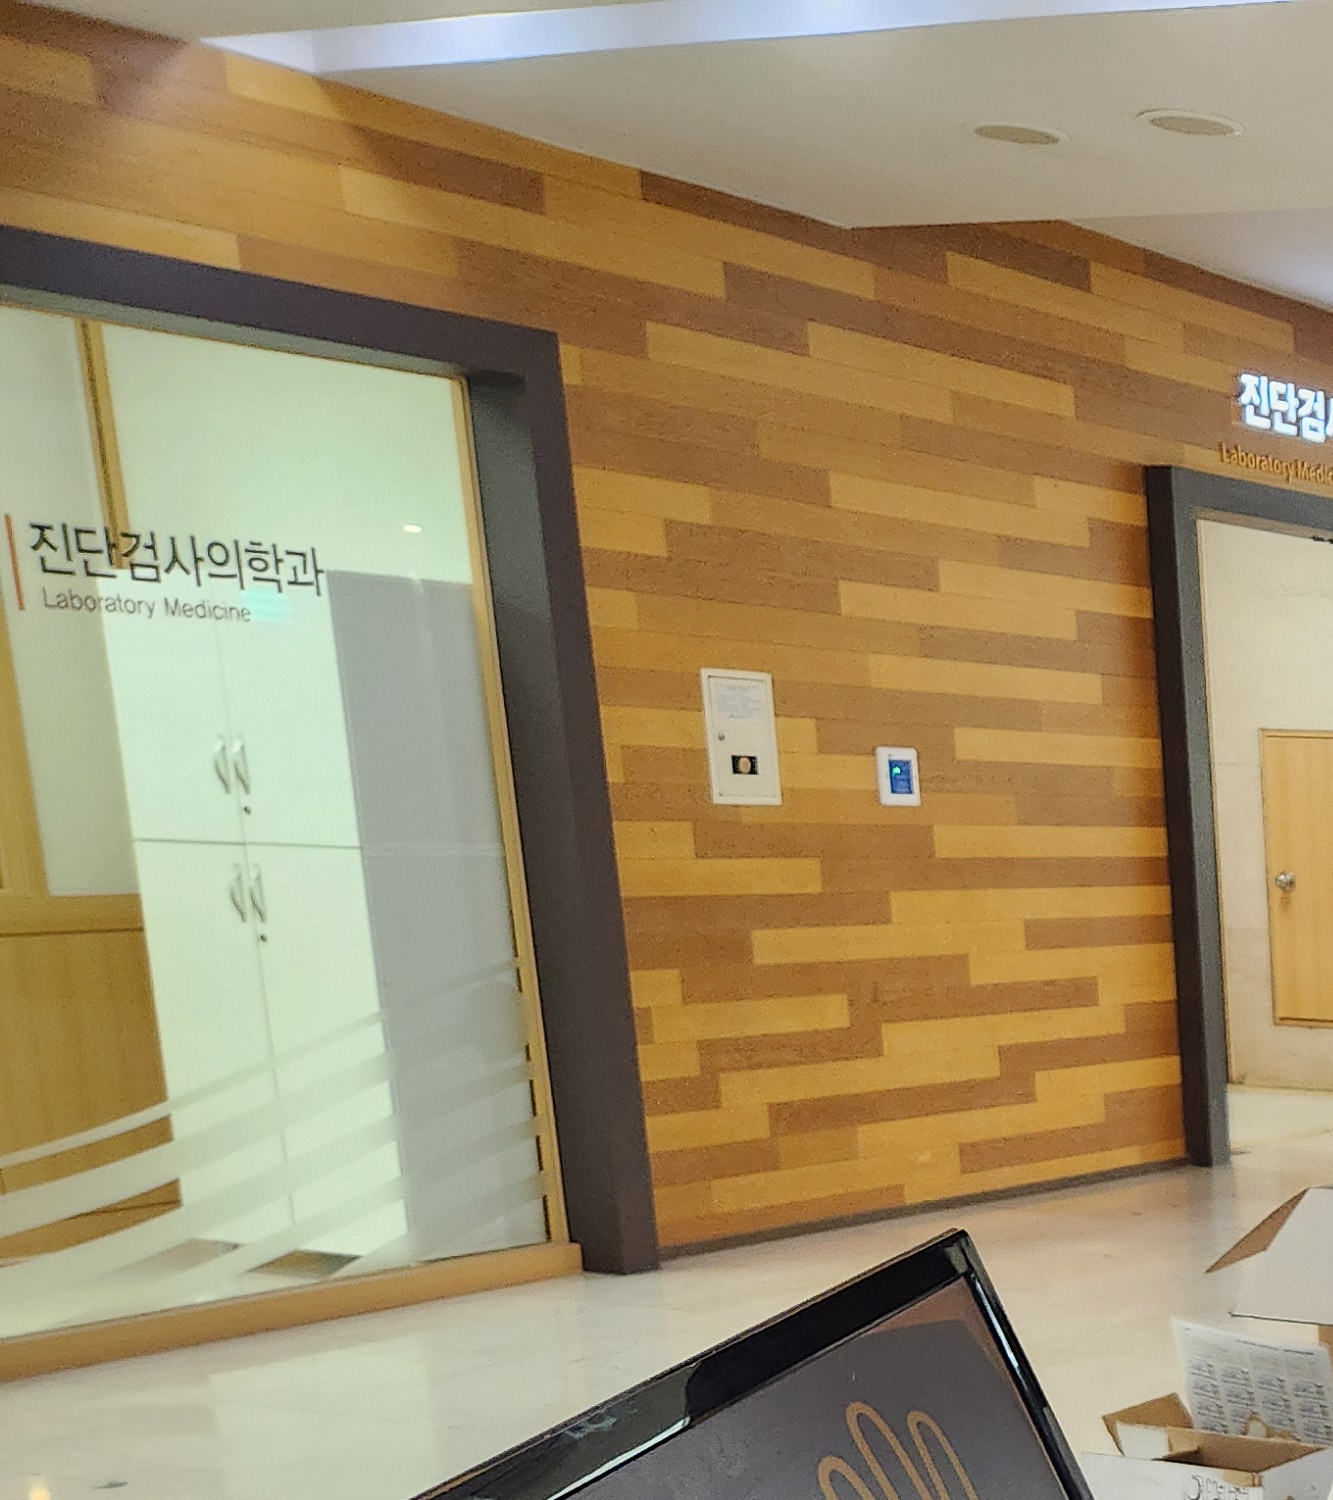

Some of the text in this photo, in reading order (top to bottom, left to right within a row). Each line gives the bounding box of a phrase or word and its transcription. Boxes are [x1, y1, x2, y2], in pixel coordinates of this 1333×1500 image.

[1219, 443, 1295, 484] Laboratory
[28, 521, 325, 596] 진단검사의학과
[42, 587, 252, 622] Laboratory Medicine
